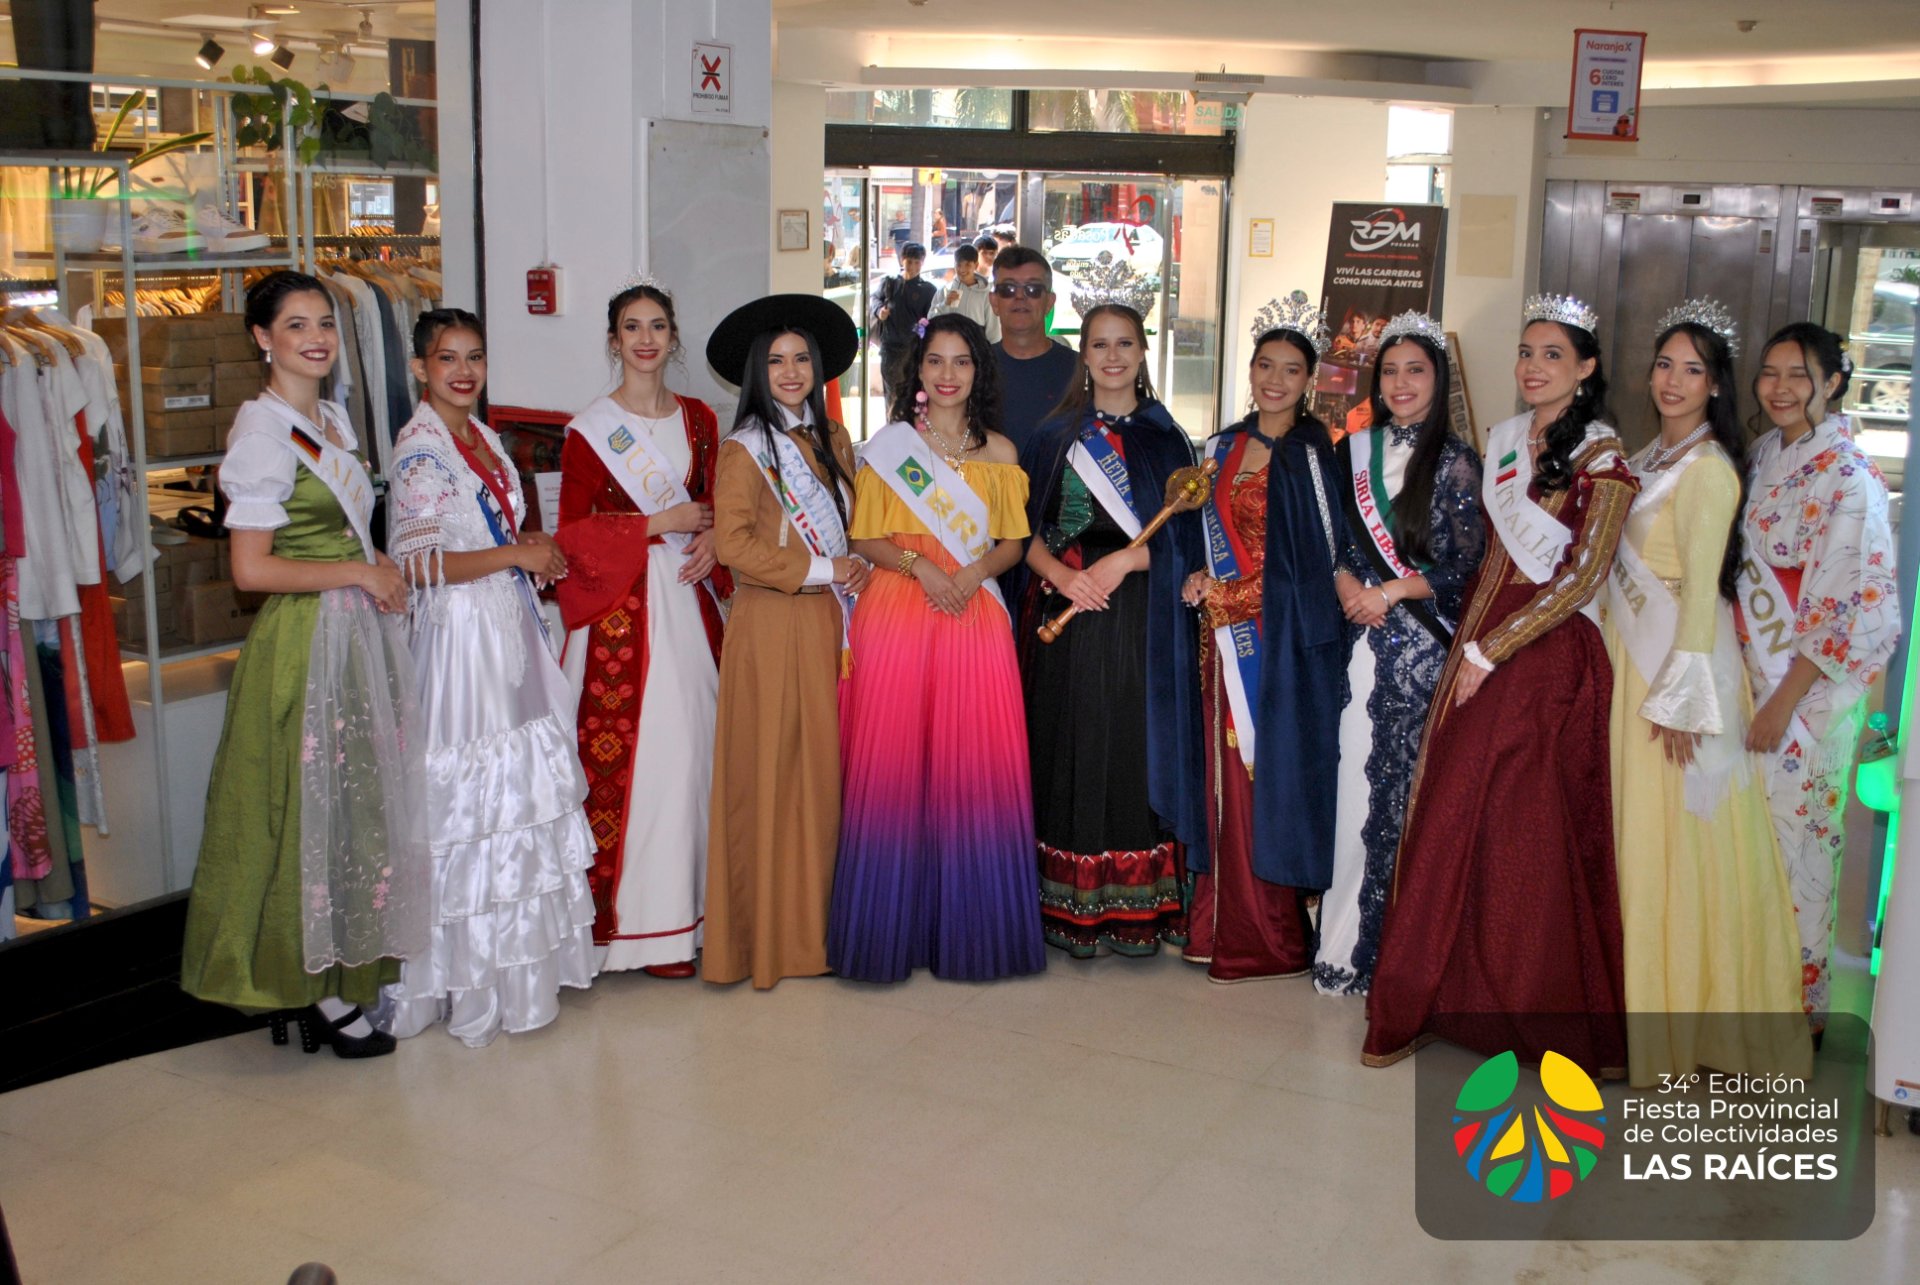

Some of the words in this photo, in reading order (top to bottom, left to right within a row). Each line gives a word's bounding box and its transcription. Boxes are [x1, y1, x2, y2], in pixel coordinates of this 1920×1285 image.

[1590, 69, 1601, 85] 6
[1195, 105, 1244, 119] SALDA
[1350, 220, 1421, 241] RPM
[1355, 268, 1372, 276] LAS
[1373, 269, 1422, 278] CARRERAS
[1333, 277, 1360, 286] COMO
[1361, 279, 1393, 287] NUNCA
[1393, 280, 1424, 289] ANTES
[1098, 450, 1131, 497] REINA
[1354, 469, 1374, 519] SIRIA
[1496, 482, 1560, 569] ITALIA
